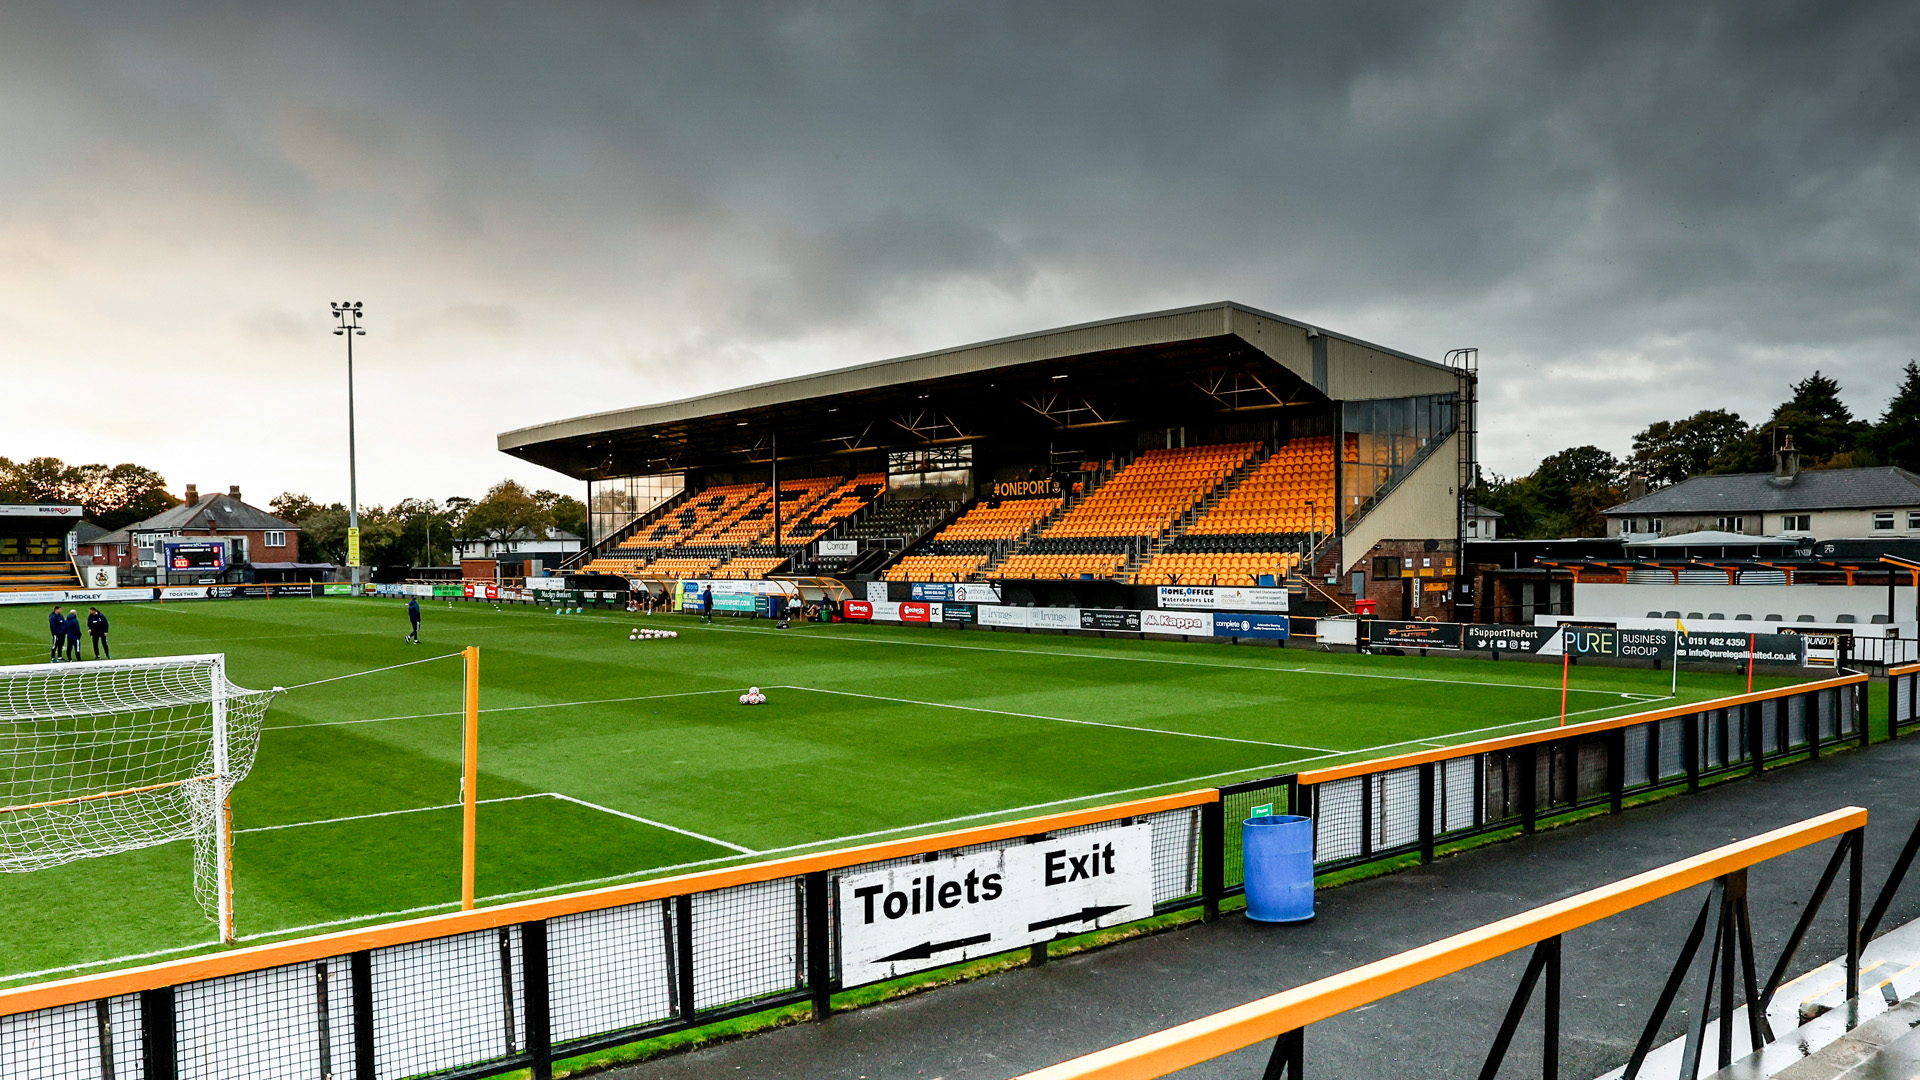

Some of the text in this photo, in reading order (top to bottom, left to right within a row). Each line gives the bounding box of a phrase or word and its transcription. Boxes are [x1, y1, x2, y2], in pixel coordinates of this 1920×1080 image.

[994, 480, 1051, 496] #ONEPORT
[988, 608, 1012, 620] Irvings
[1041, 610, 1067, 622] Irvings
[1159, 615, 1202, 629] Kappa
[1216, 620, 1240, 629] complete
[1469, 628, 1538, 638] #SupportThePort
[1565, 632, 1612, 653] PURE
[1622, 634, 1666, 645] BUSINESS
[1688, 637, 1746, 647] 0151 482 4350
[1622, 646, 1658, 656] GROUP
[1045, 842, 1116, 886] Exit
[856, 869, 1002, 924] Toilets
